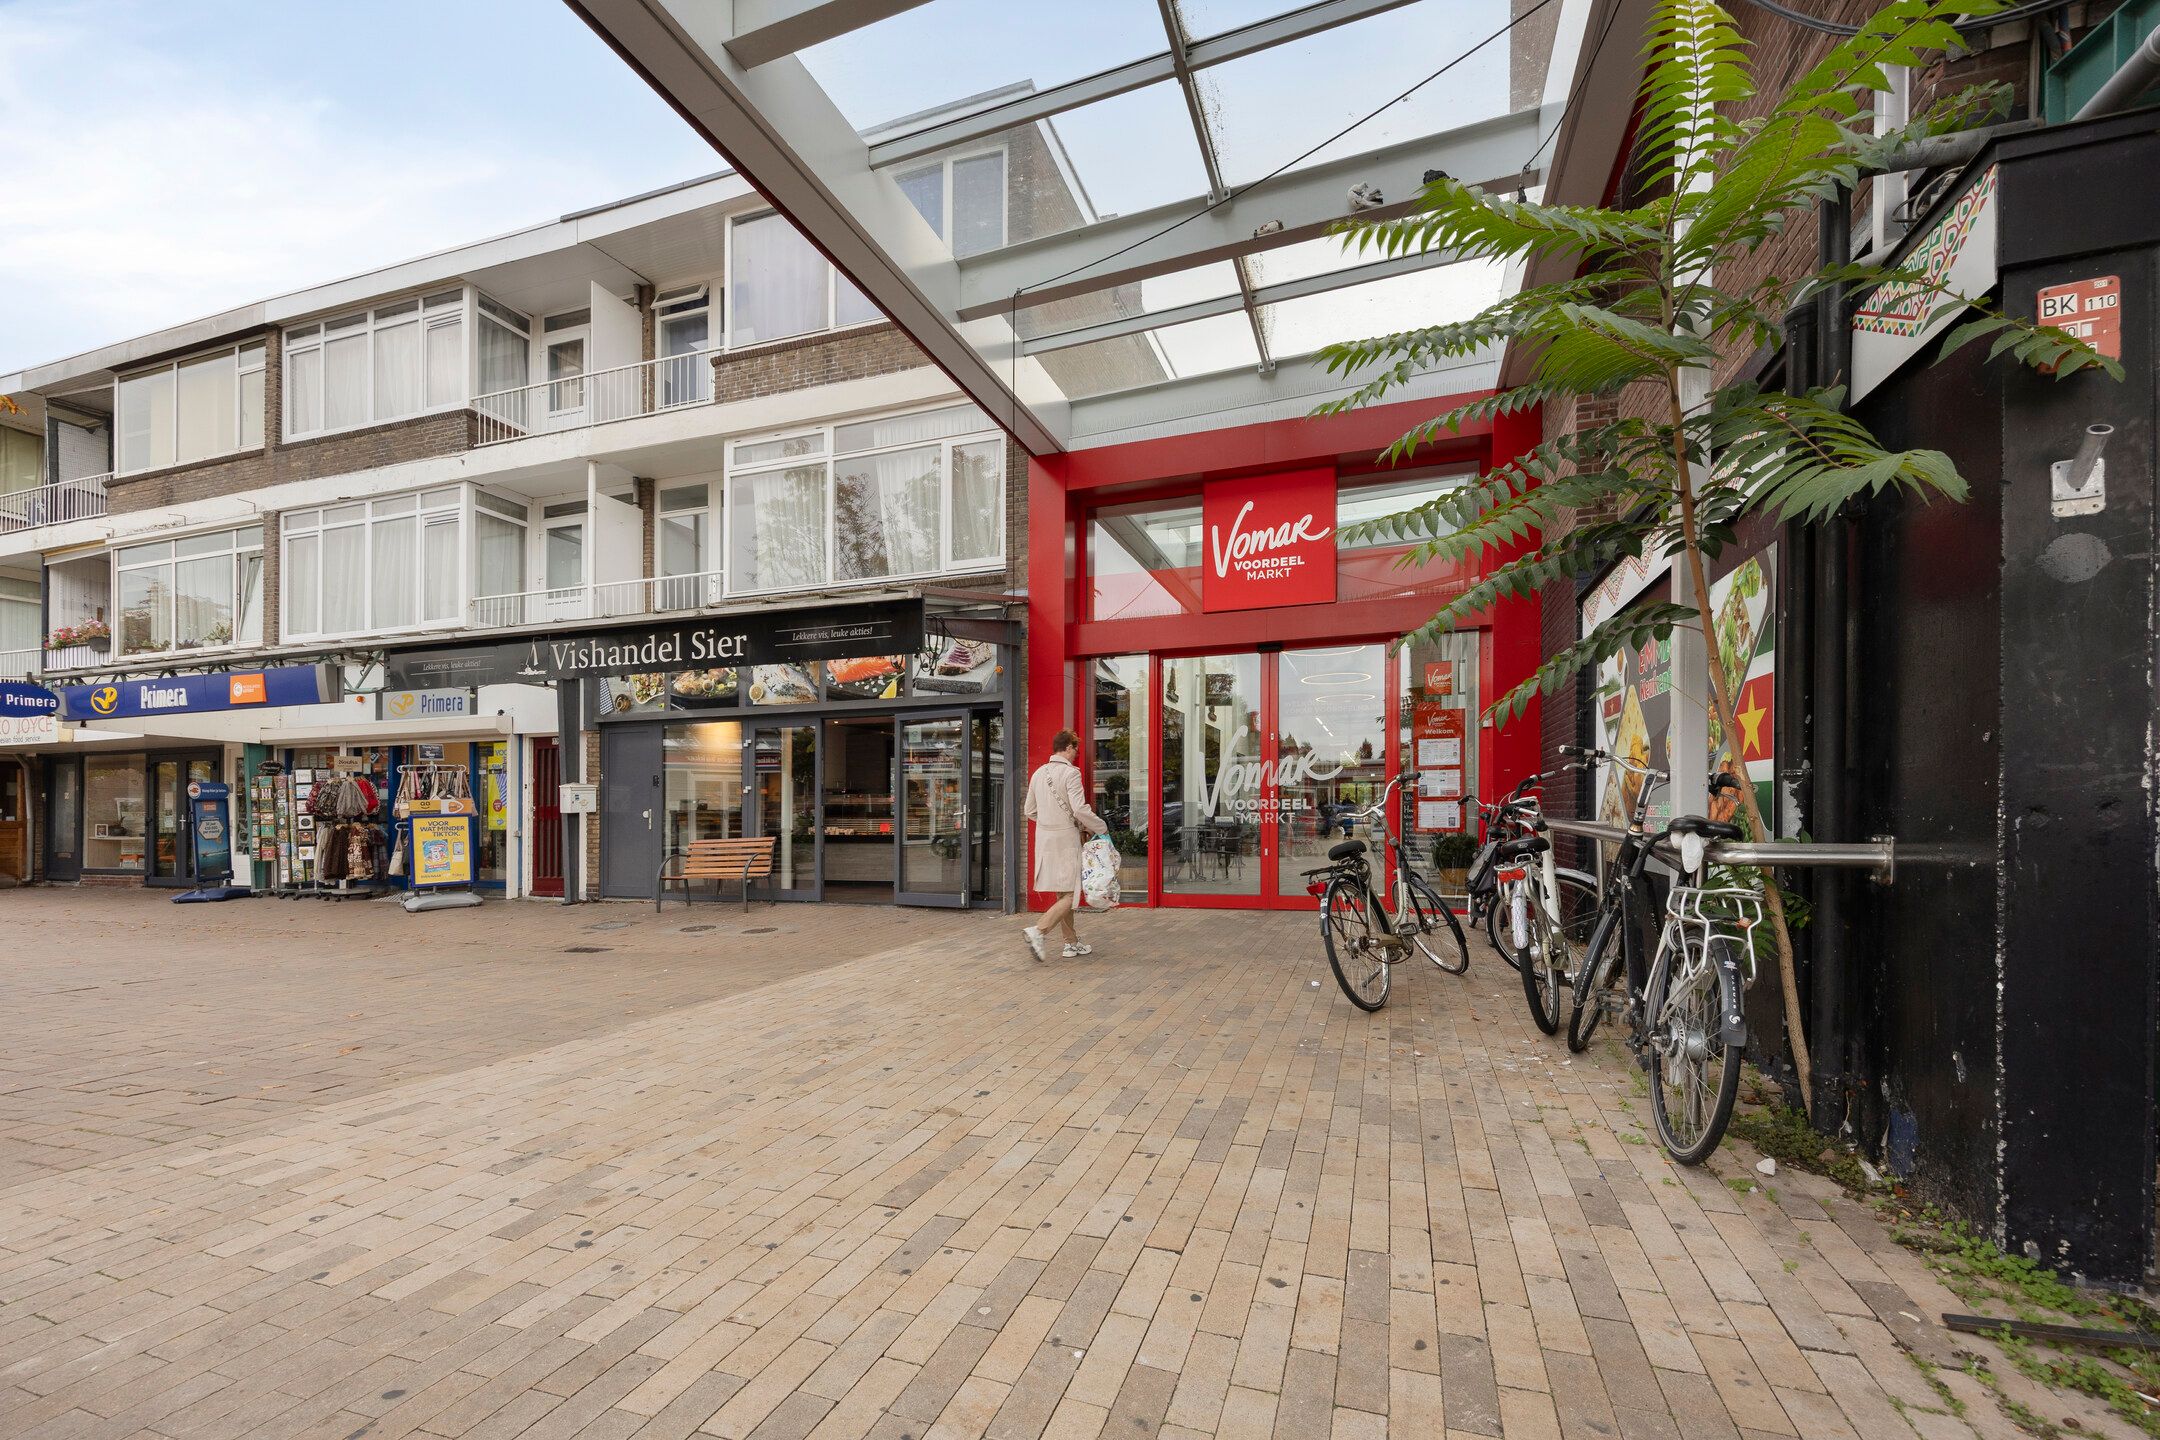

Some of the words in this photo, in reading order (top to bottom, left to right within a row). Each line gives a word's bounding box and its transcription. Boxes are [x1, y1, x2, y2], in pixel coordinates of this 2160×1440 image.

[2043, 294, 2075, 318] BK
[2088, 295, 2117, 310] 110
[1211, 500, 1331, 578] Vomar
[1234, 555, 1306, 571] VOORDEEL
[1247, 567, 1292, 581] MARKT
[792, 631, 817, 641] Lekkere
[818, 630, 829, 640] vis,
[830, 629, 848, 638] leuke
[849, 626, 873, 636] akties!
[550, 632, 683, 671] Vishandel
[691, 629, 748, 660] Sier
[6, 693, 57, 708] Primera
[140, 685, 188, 709] Primera
[421, 693, 463, 714] Primera
[16, 717, 52, 734] JOYCE
[1225, 798, 1312, 811] VOORDEEL
[1239, 812, 1296, 824] MARKT
